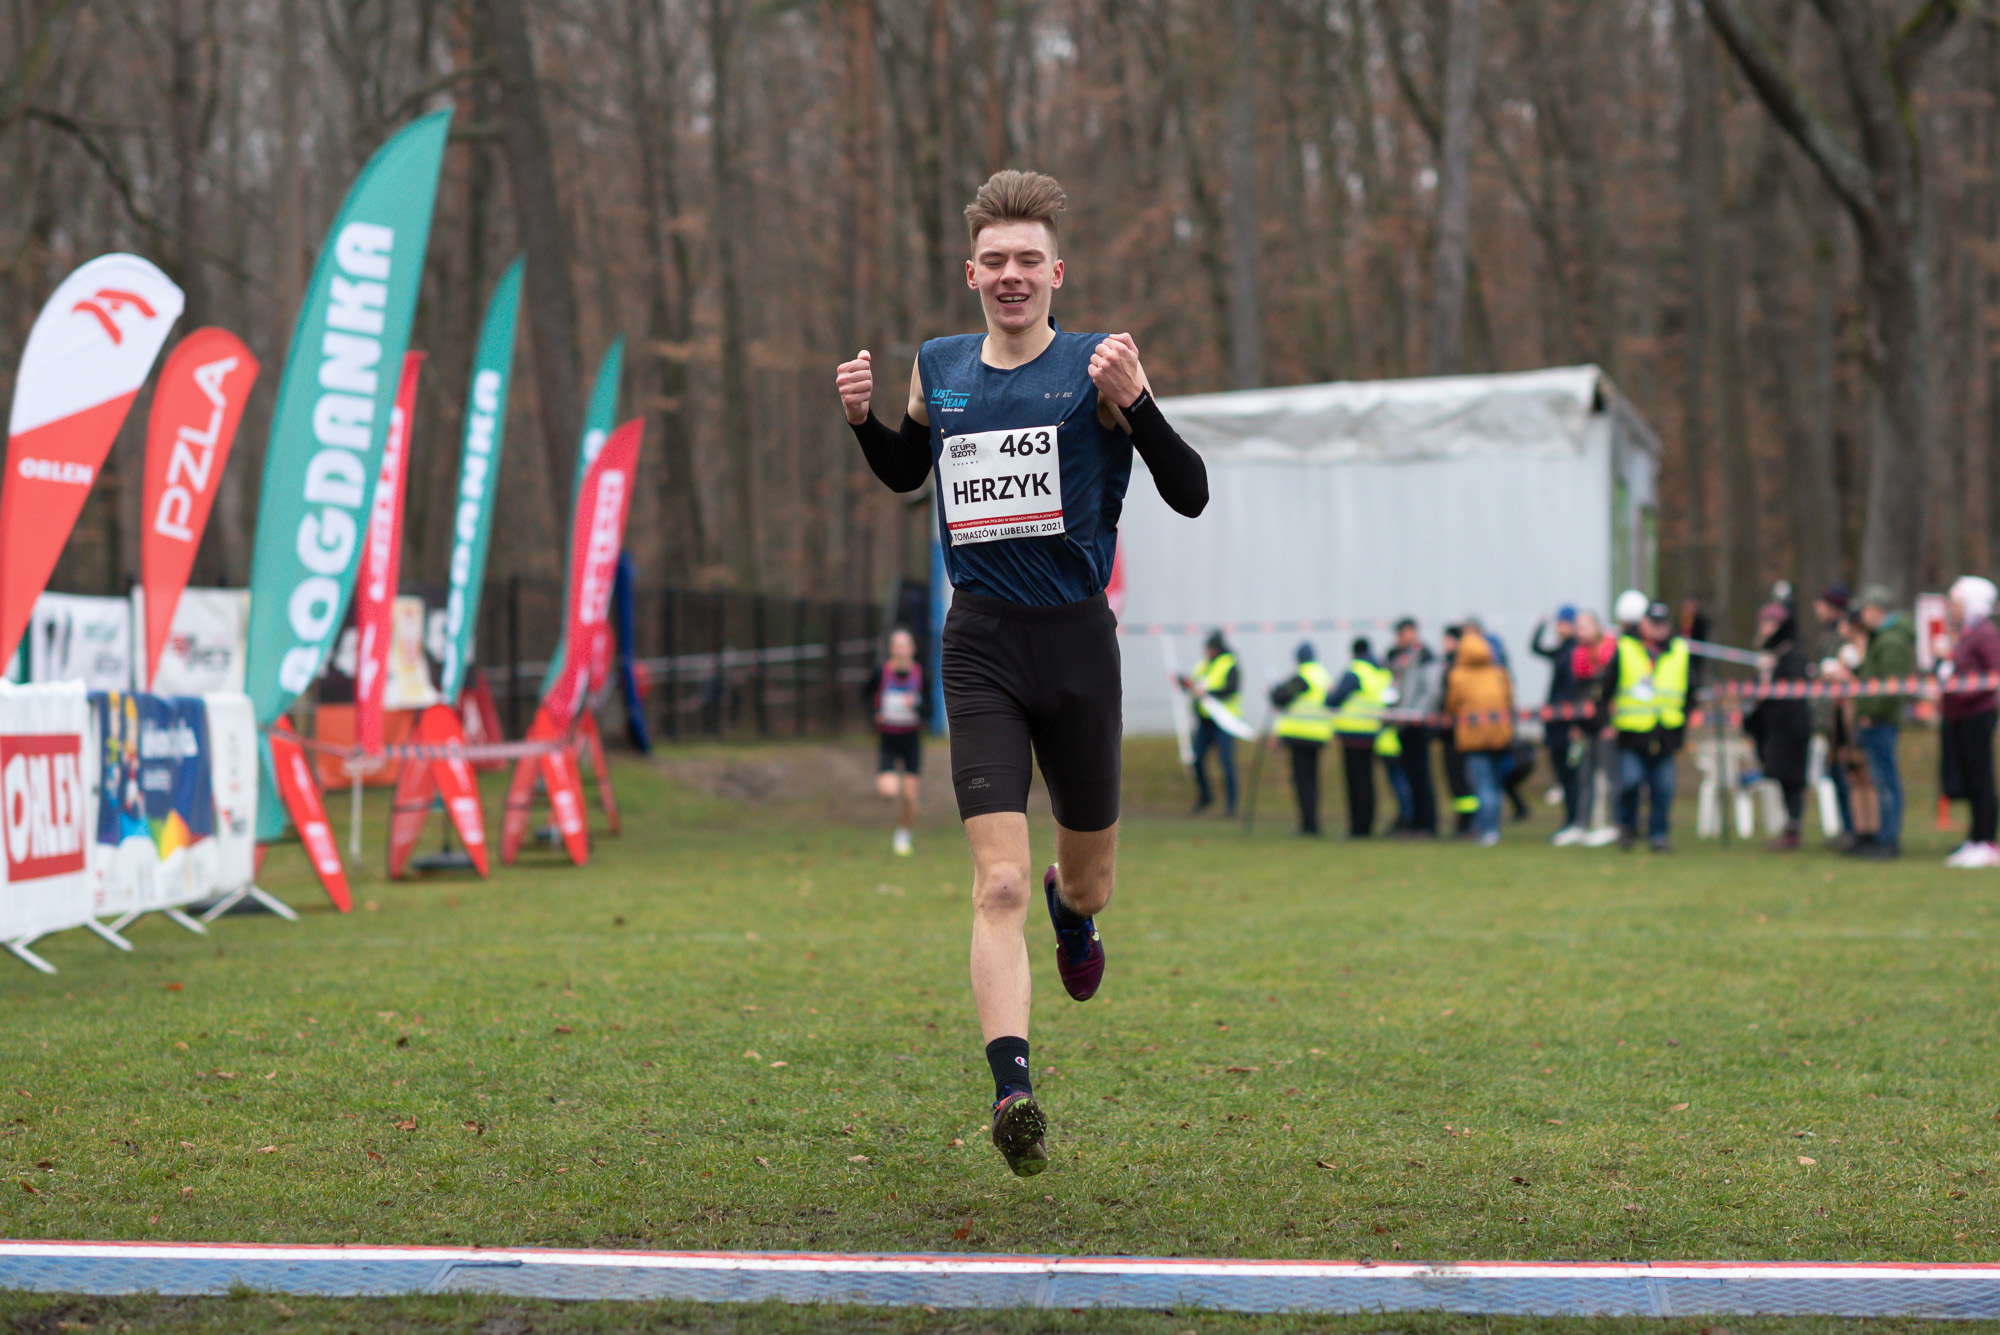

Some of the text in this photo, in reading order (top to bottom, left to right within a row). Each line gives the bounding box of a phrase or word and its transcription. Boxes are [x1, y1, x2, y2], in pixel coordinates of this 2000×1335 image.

[931, 388, 953, 399] JUST
[942, 398, 969, 408] TEAM
[154, 355, 239, 543] PZLA
[999, 431, 1051, 458] 463
[18, 456, 94, 487] ORLEN
[953, 471, 1052, 506] HERZYK
[953, 521, 1061, 542] TOMASZÓW LUBELSKI 2021
